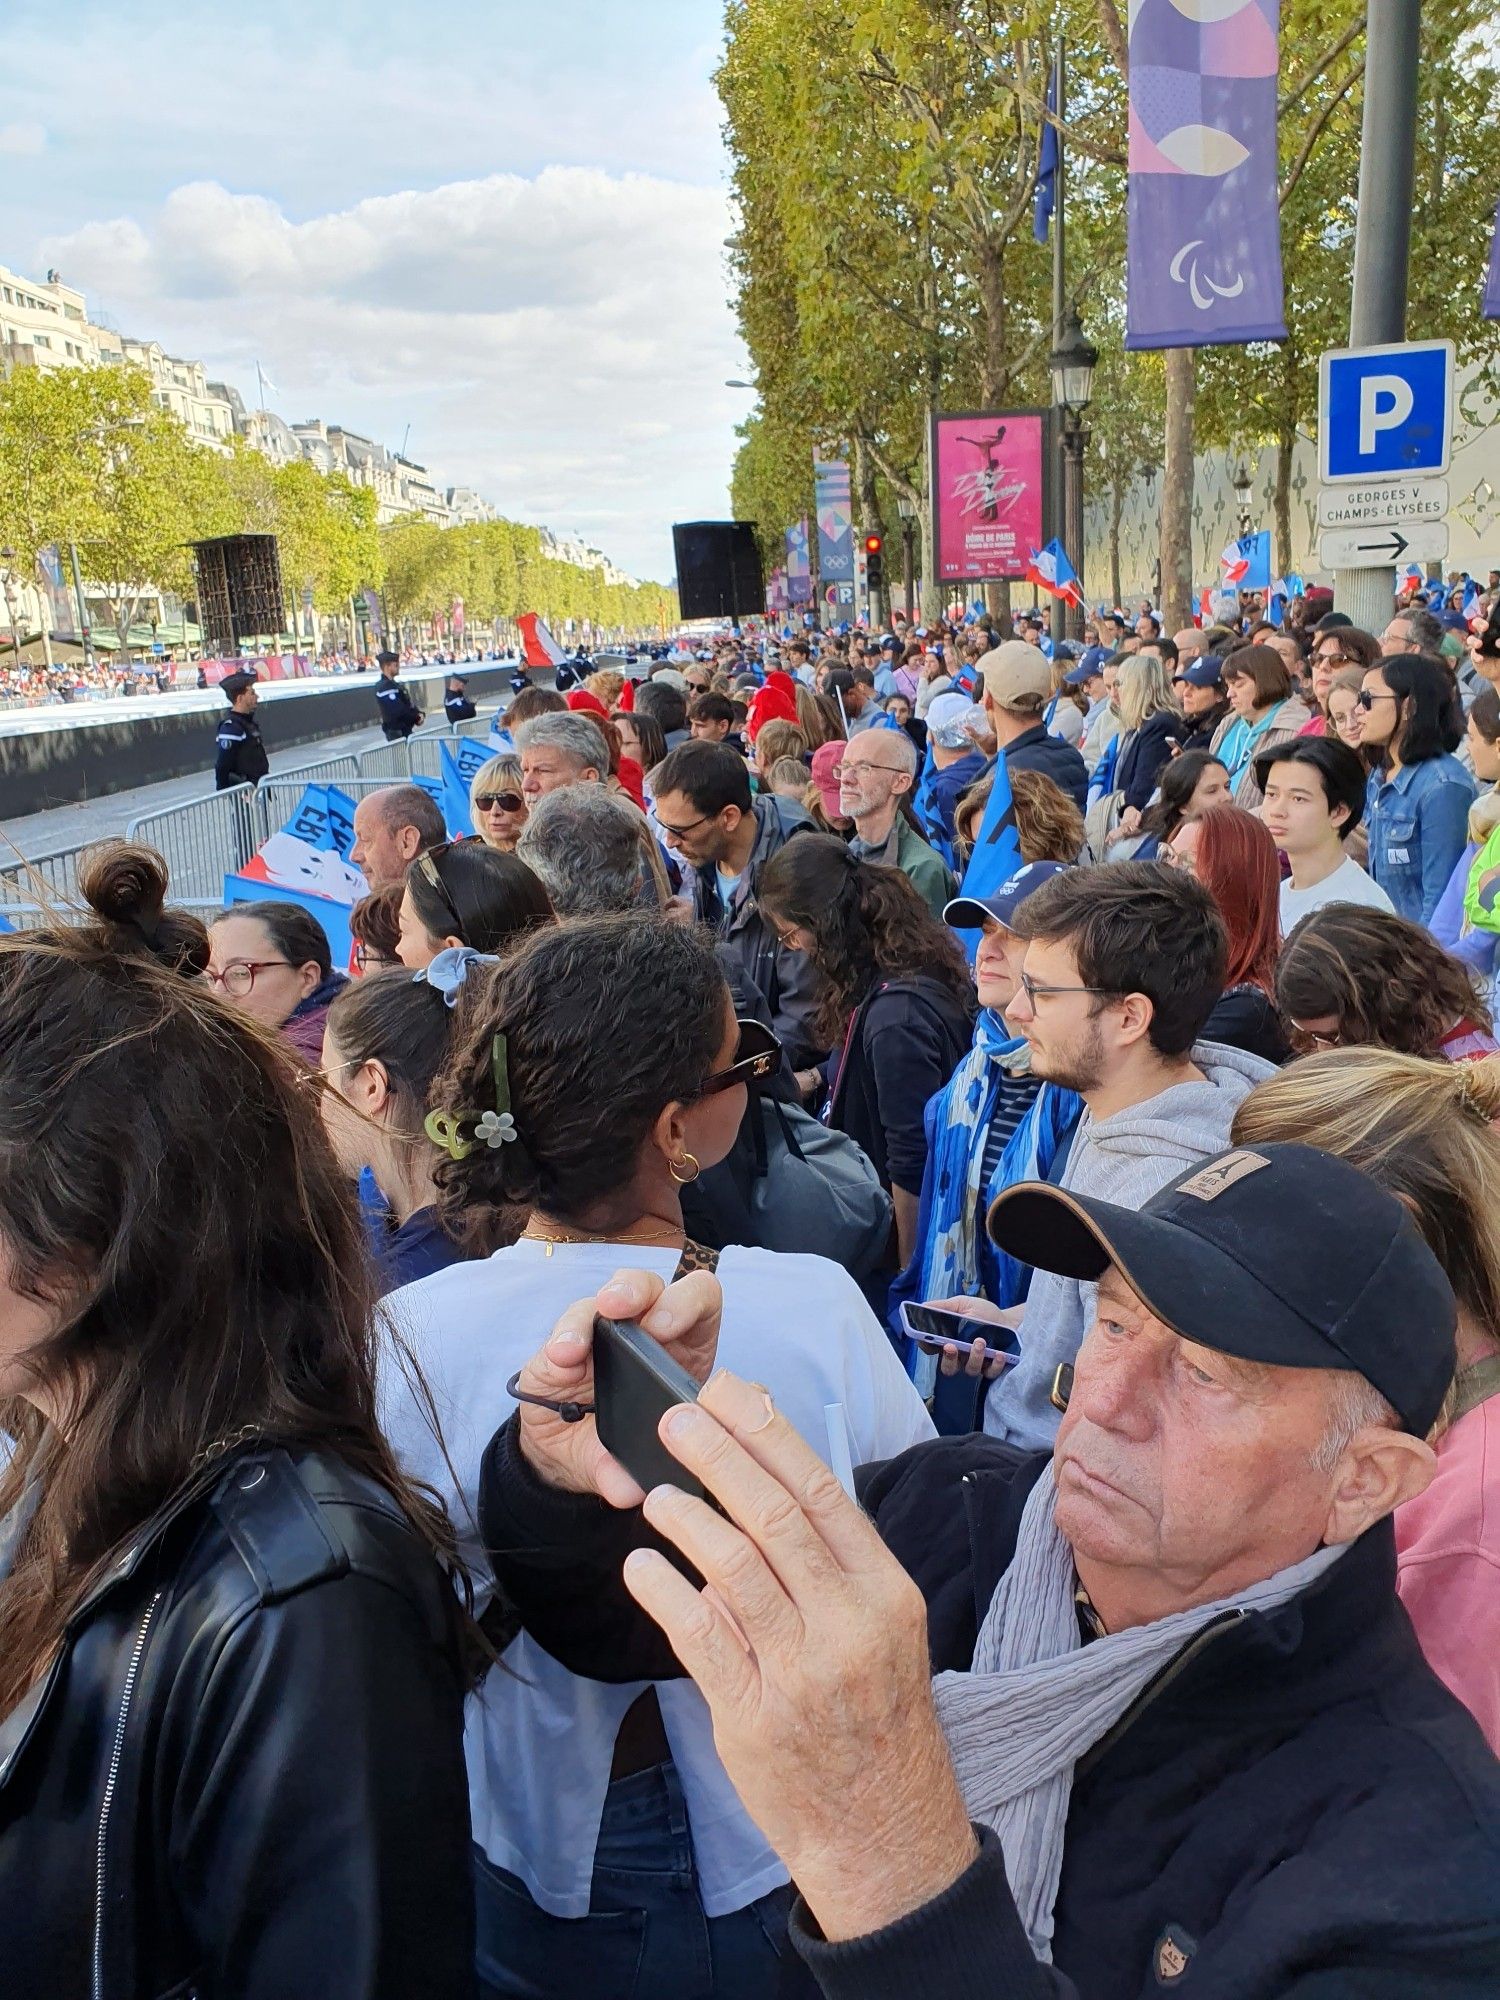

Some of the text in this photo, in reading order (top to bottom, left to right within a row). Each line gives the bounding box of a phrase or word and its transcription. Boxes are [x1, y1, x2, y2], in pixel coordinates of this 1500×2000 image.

[1359, 374, 1414, 455] P
[1348, 488, 1420, 503] GEORGES V
[1327, 500, 1441, 521] CHAMPS-ÉLYSÉES
